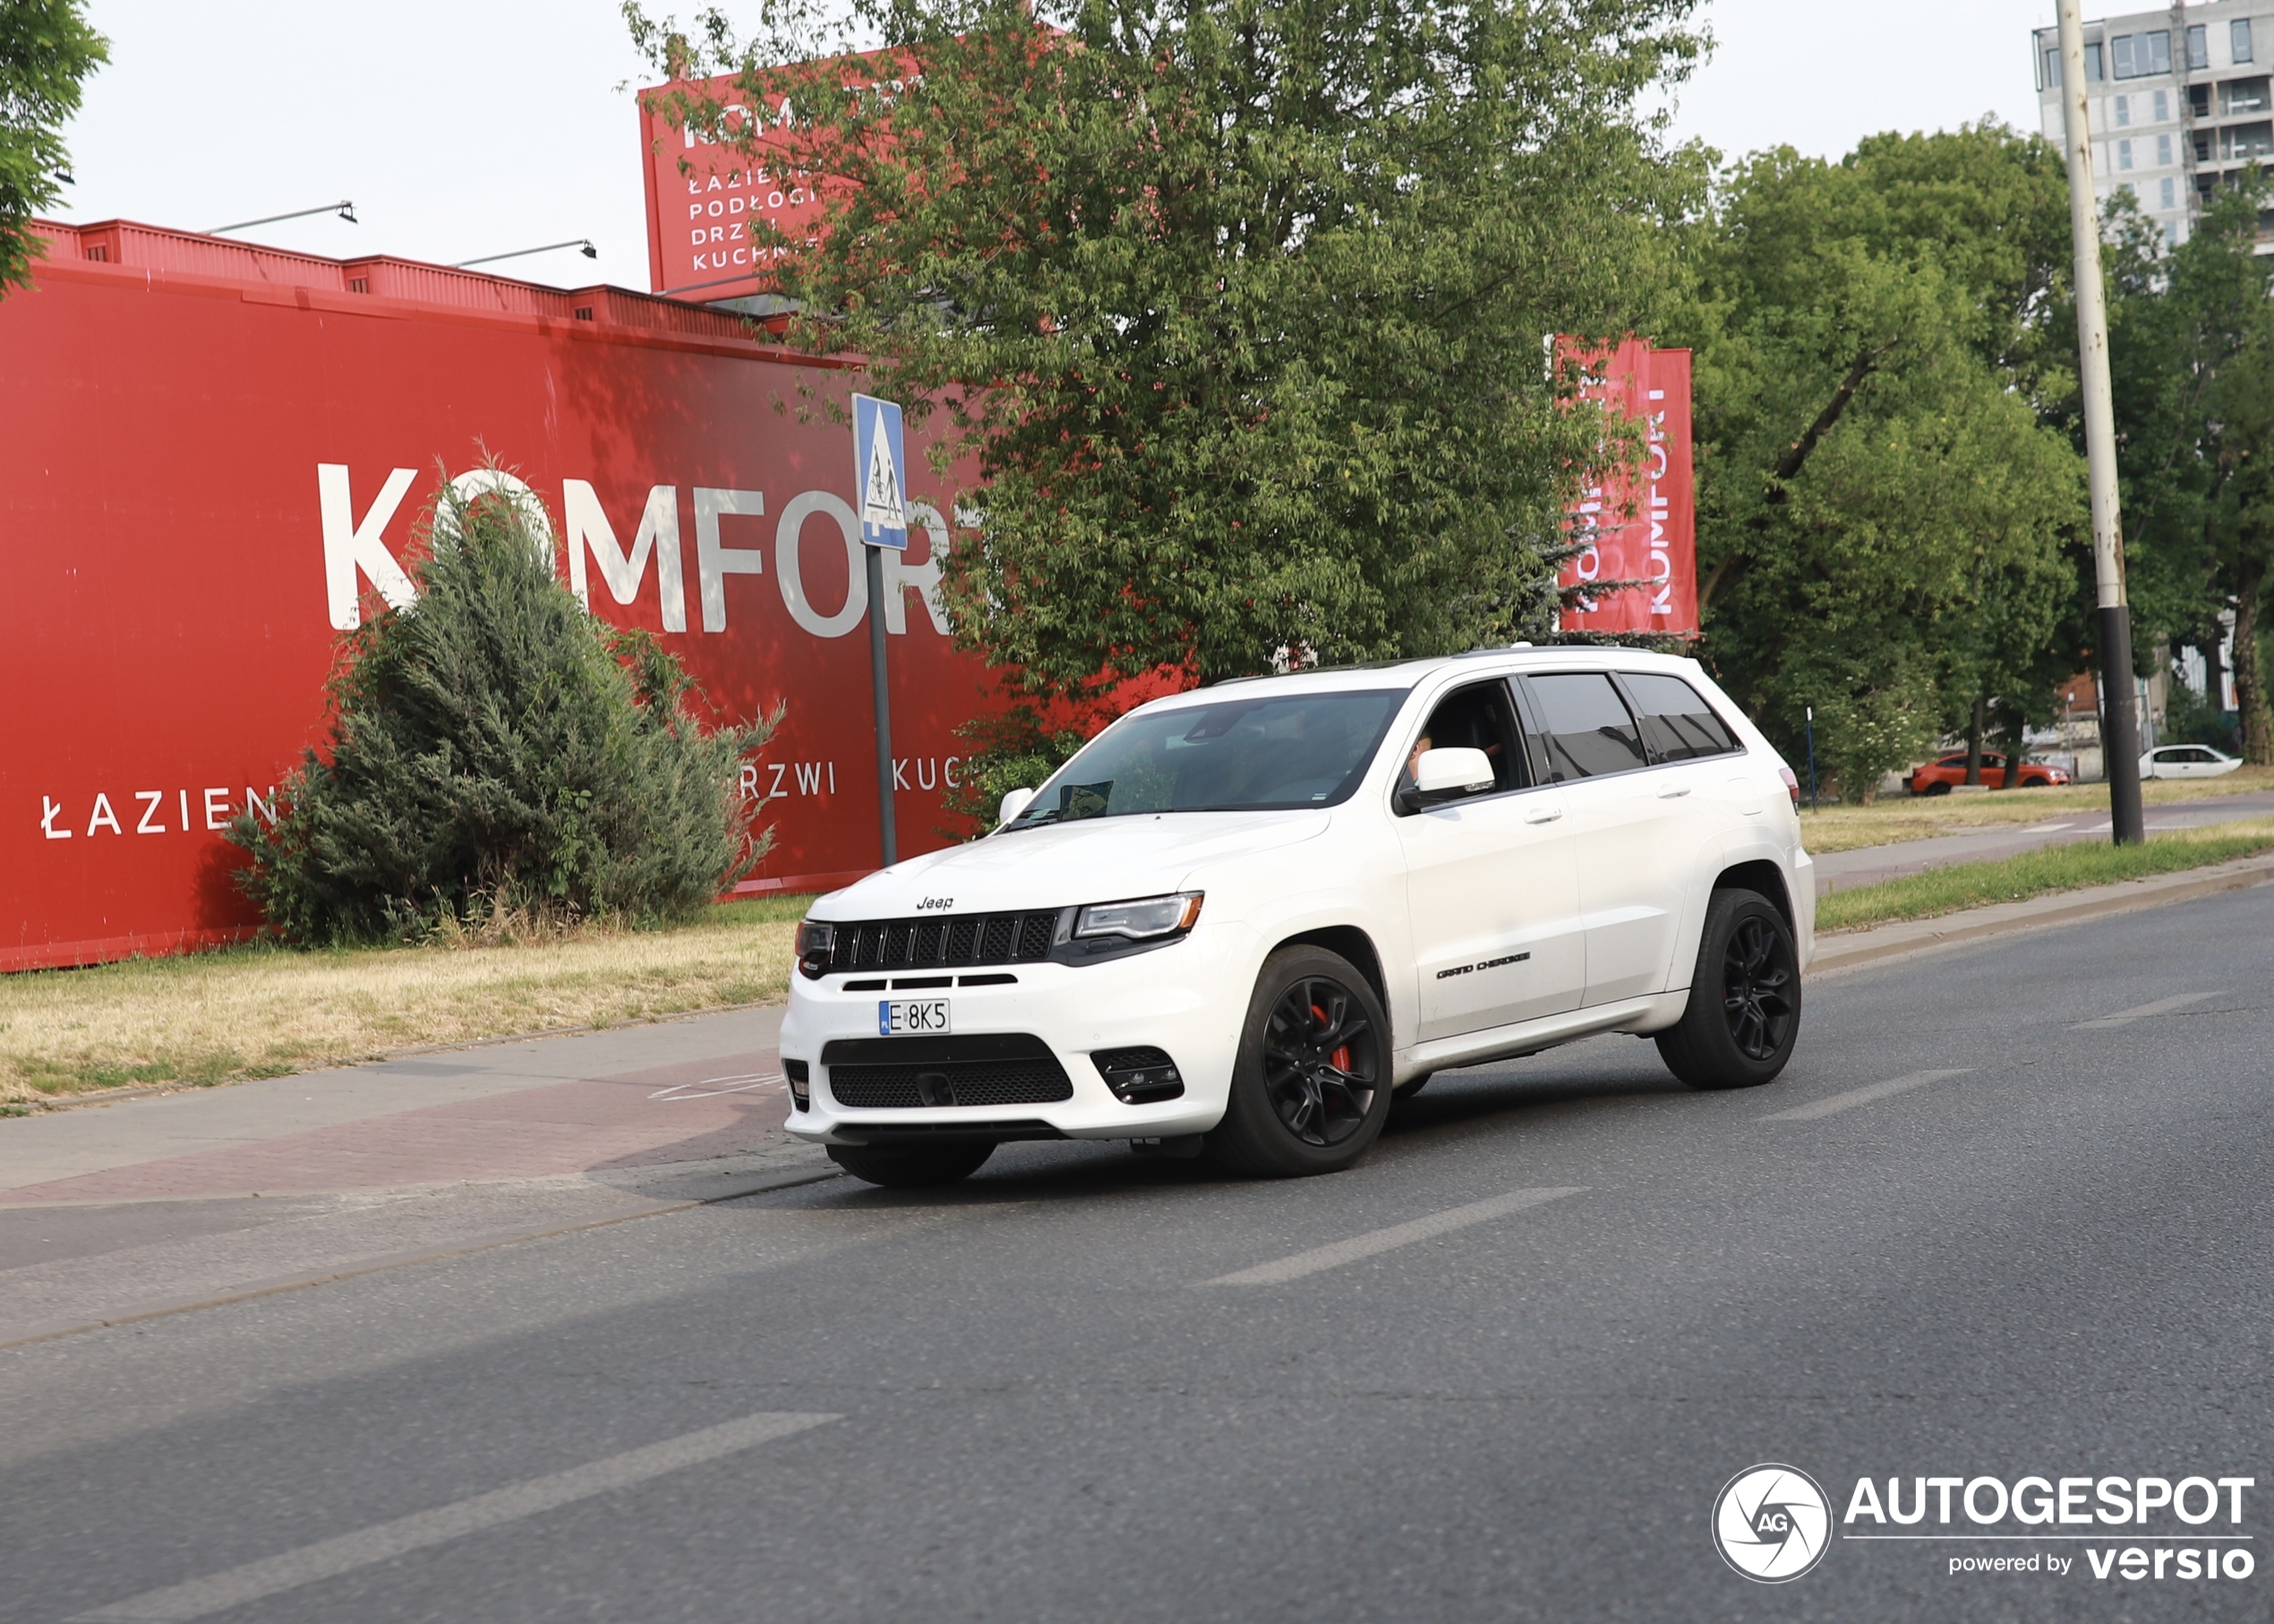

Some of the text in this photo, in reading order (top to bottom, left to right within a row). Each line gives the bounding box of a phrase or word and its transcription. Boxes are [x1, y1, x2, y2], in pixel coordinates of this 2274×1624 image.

[689, 188, 816, 220] PODŁOGI
[691, 218, 776, 245] DRZI
[739, 761, 836, 799] RZWI
[40, 785, 298, 839] ŁAZIEN
[917, 896, 954, 911] Jeep
[1436, 952, 1531, 979] GRAND CHEROKEE
